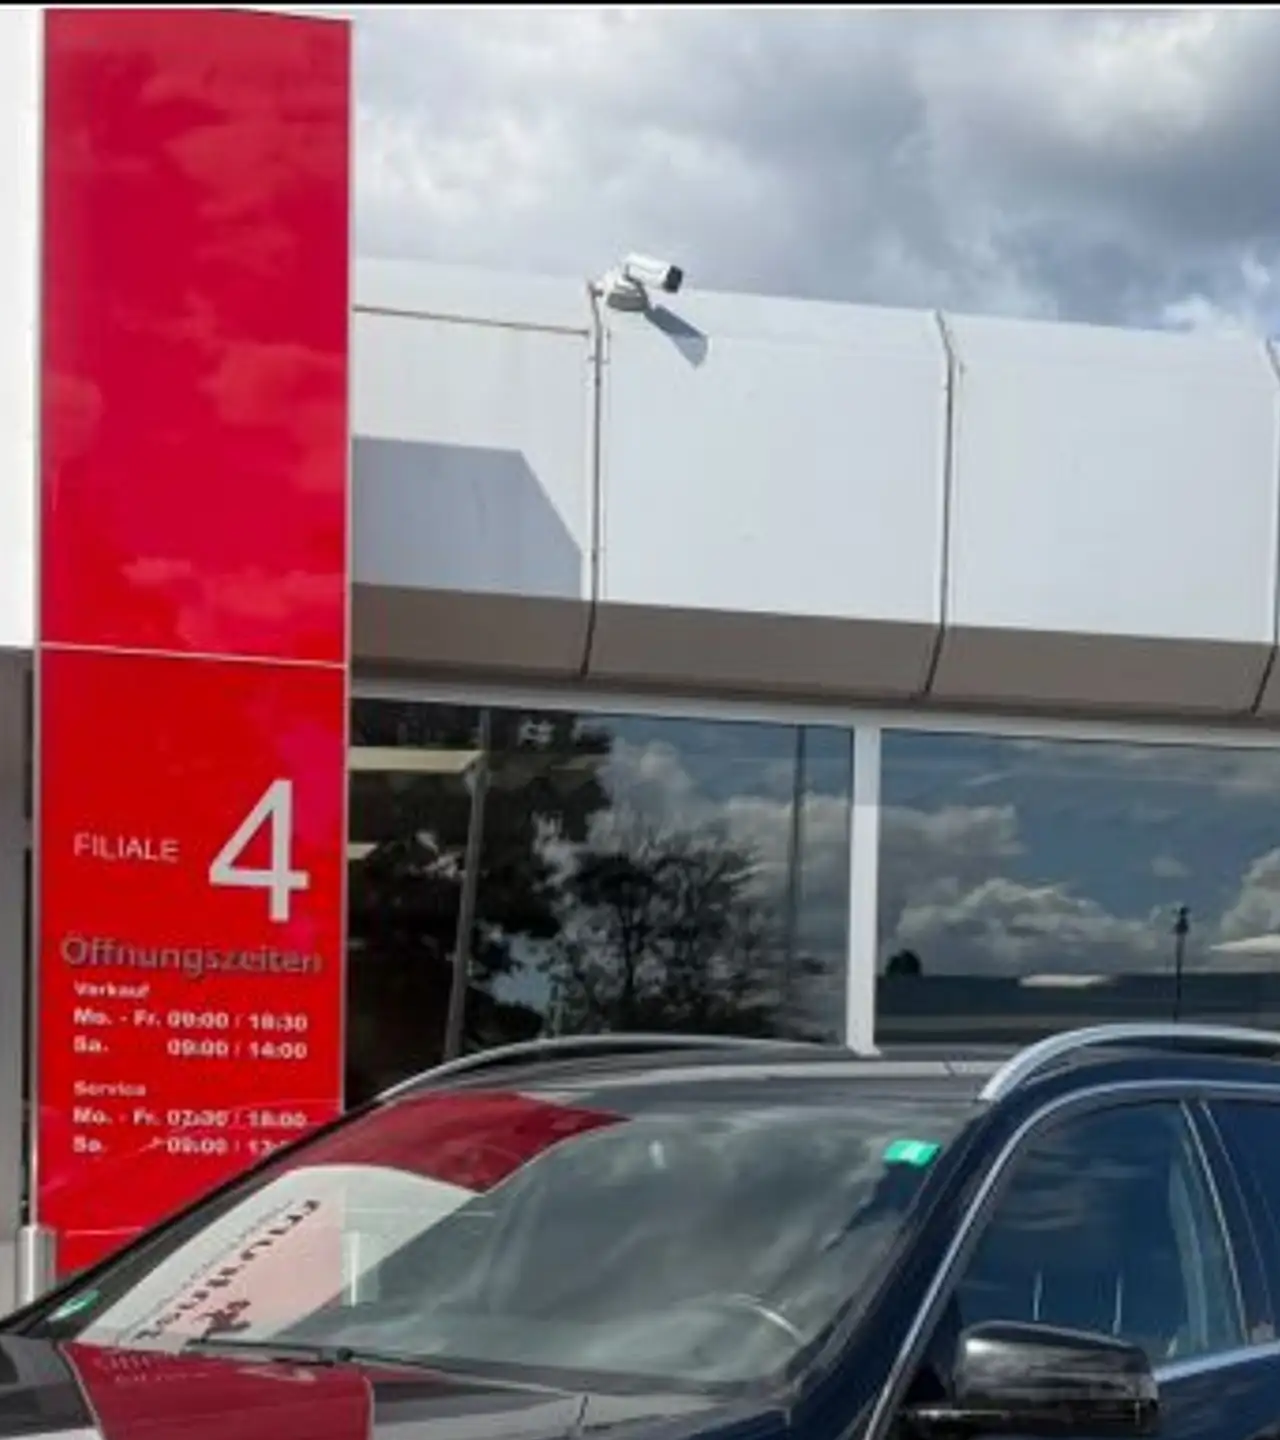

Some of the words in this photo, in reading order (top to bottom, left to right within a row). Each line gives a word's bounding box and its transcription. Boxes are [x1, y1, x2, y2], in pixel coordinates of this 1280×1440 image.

[73, 832, 180, 863] FILIALE
[208, 777, 311, 923] 4
[61, 930, 324, 981] Öffnungszeiten
[73, 980, 151, 999] Verkauf
[73, 1007, 113, 1026] Mo.
[133, 1009, 162, 1028] Fr.
[73, 1035, 110, 1054] Sa.
[166, 1037, 230, 1057] 09:00
[248, 1041, 308, 1060] 14:00
[73, 1080, 147, 1097] Service
[73, 1106, 113, 1126] Mo.
